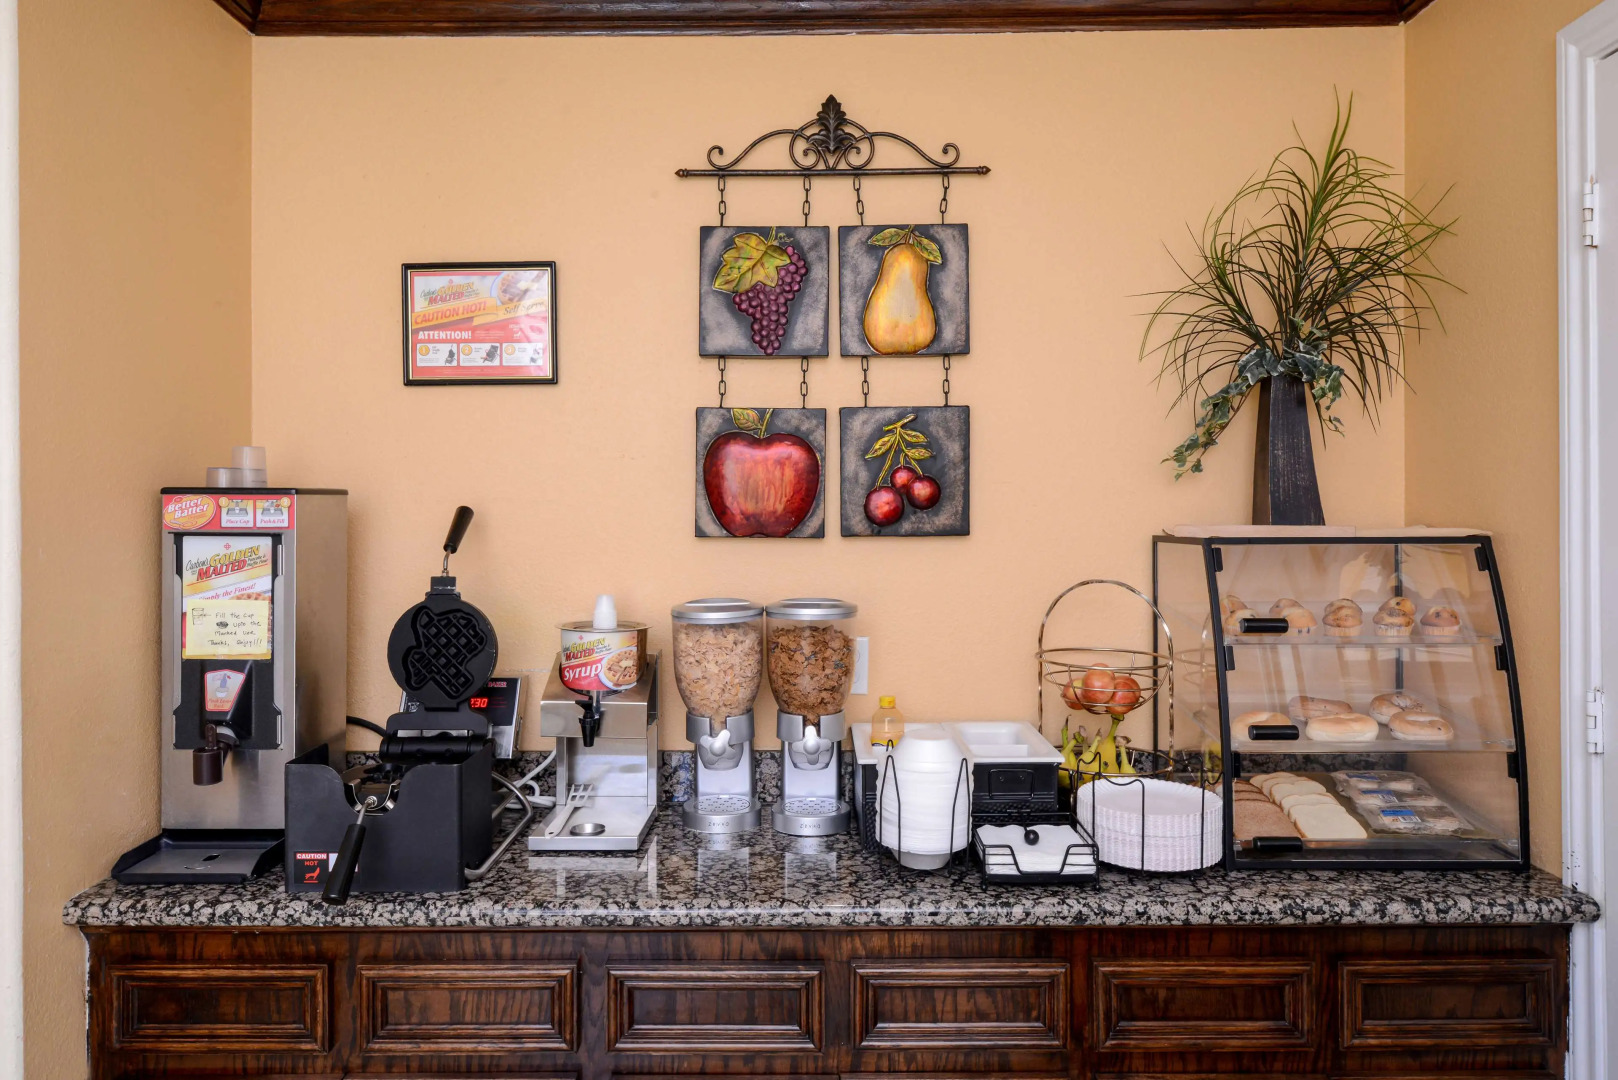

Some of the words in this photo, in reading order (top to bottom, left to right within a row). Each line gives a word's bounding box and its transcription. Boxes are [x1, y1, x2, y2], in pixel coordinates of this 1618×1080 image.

[428, 291, 465, 305] MALTED
[414, 307, 459, 325] CAUTION
[462, 301, 487, 317] HOT!
[503, 302, 520, 316] Self
[418, 330, 472, 340] ATTENTION!
[167, 497, 203, 513] Better
[175, 504, 209, 519] Batter
[209, 545, 261, 567] GOLDEN
[197, 559, 247, 581] MALTED
[222, 589, 233, 597] the
[234, 583, 257, 593] Finest!
[571, 637, 606, 653] GOLDEN
[565, 647, 596, 662] MALTED
[564, 663, 602, 682] Syrup
